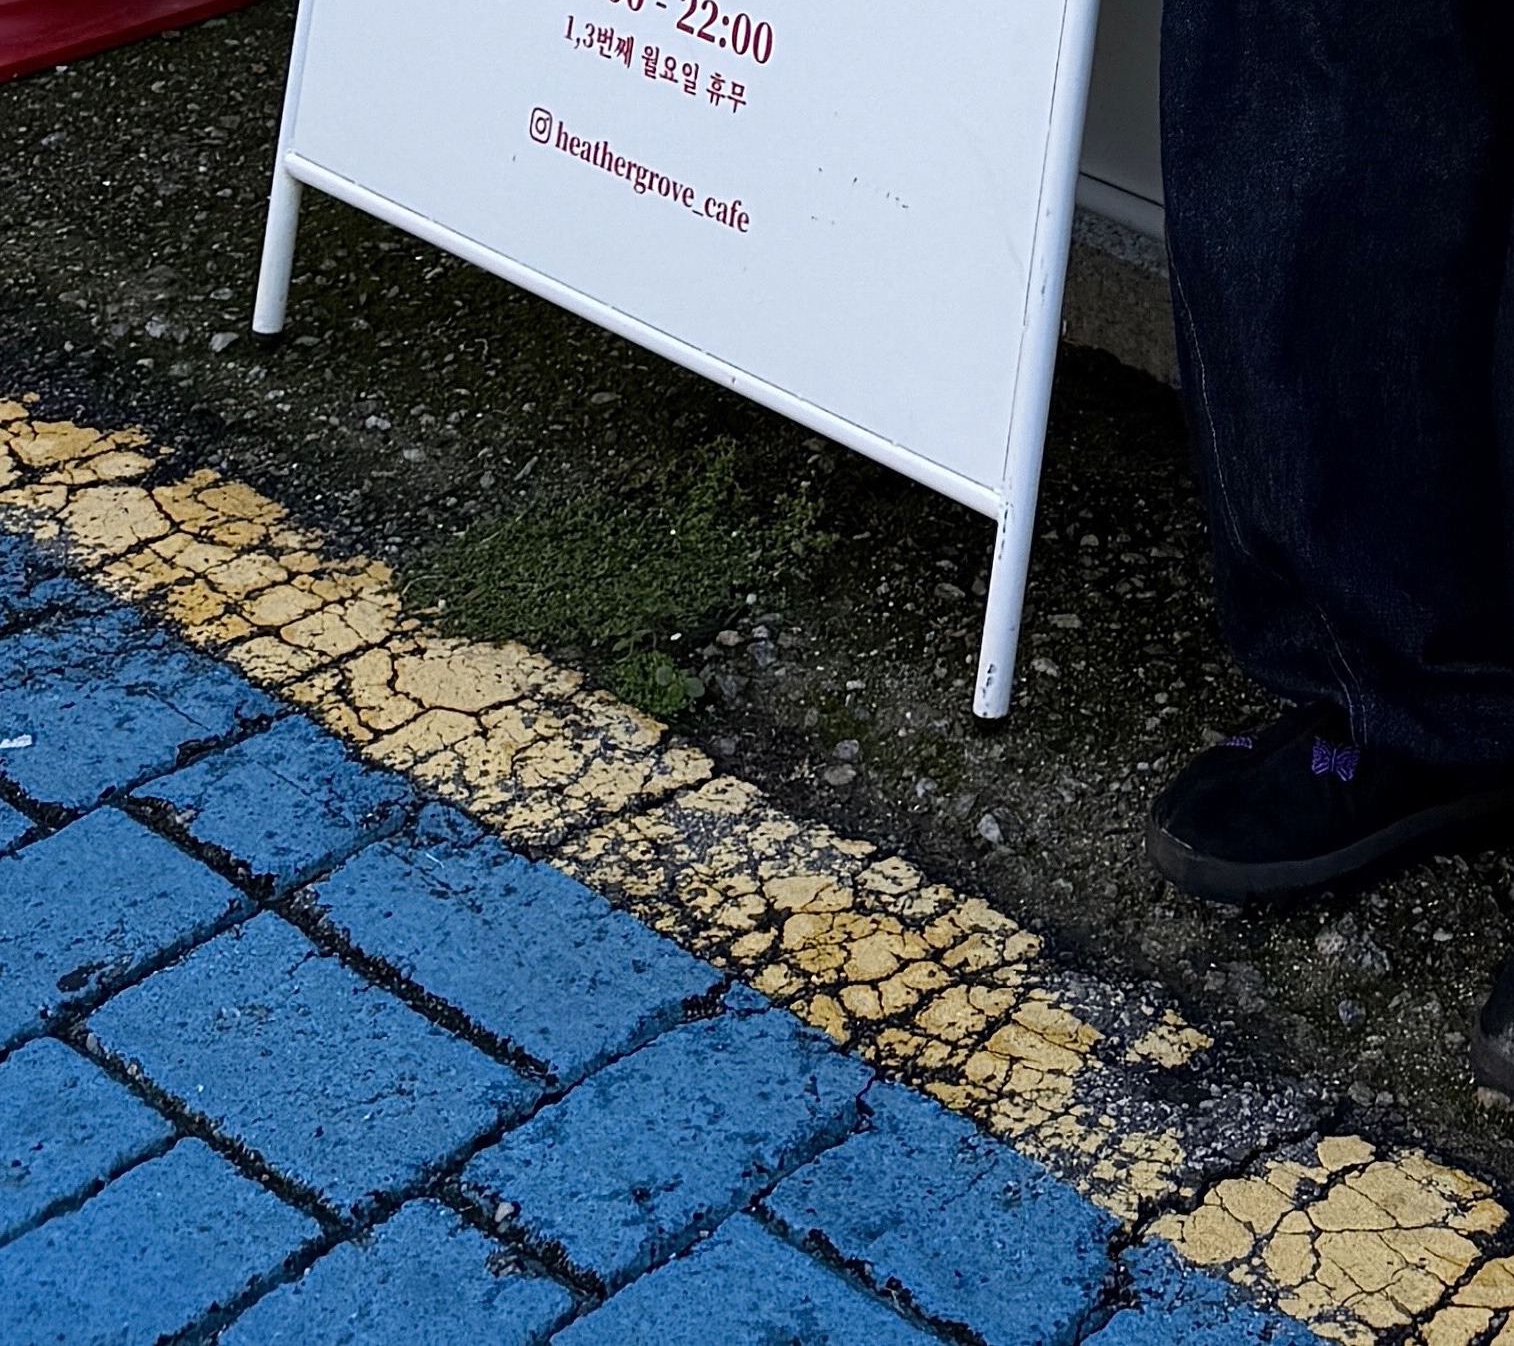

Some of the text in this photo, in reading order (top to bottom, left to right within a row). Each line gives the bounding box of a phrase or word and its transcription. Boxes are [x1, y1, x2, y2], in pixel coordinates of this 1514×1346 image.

[565, 15, 747, 114] 1,3번째 월요일 휴무
[555, 120, 750, 233] heathergrove_cafe
